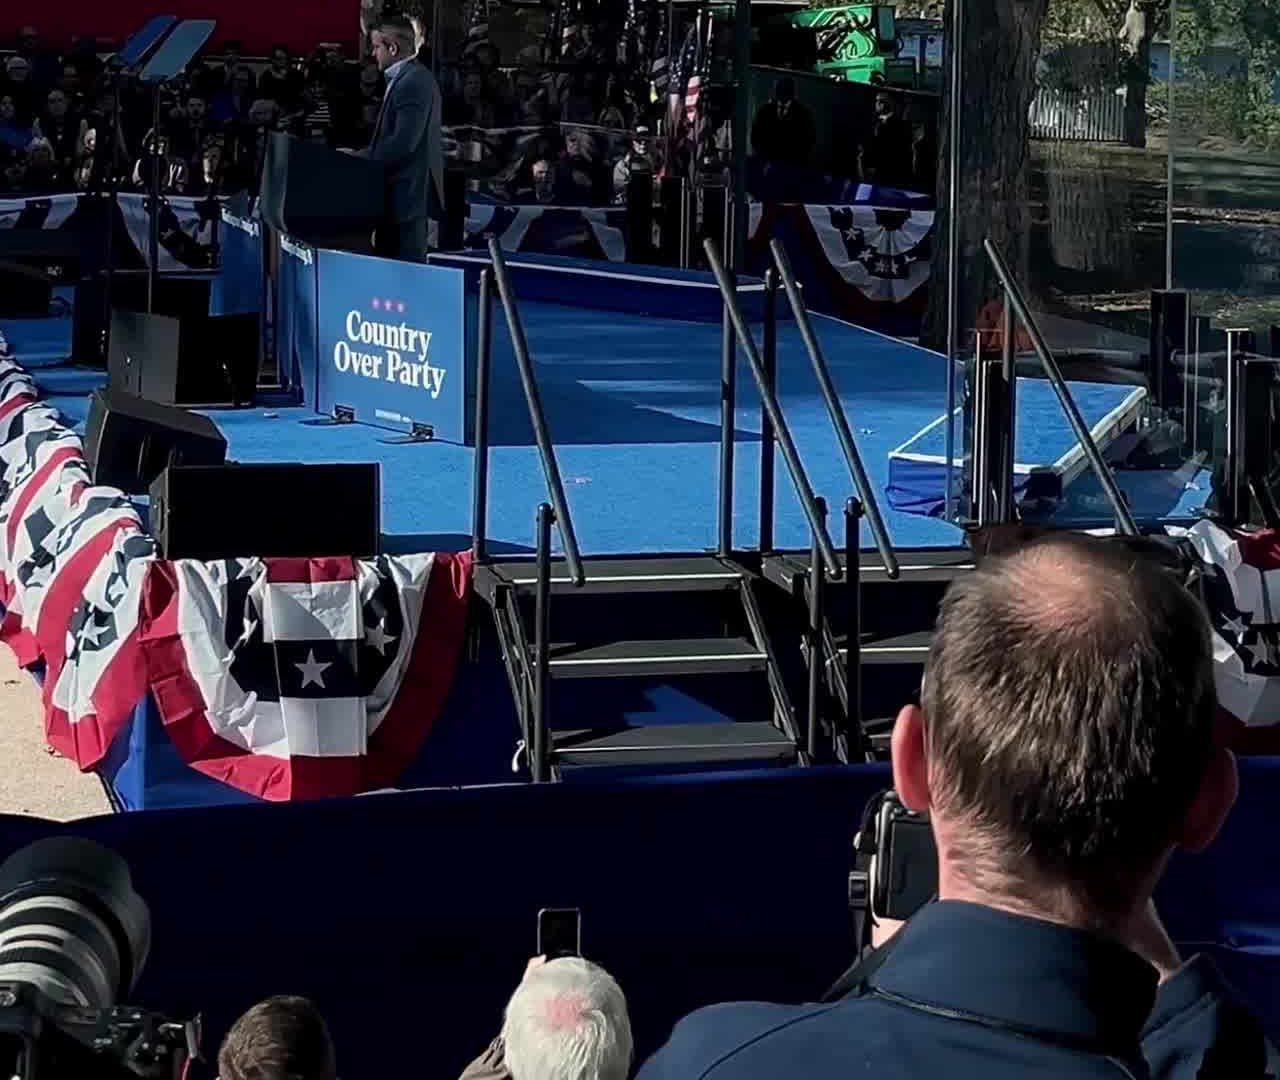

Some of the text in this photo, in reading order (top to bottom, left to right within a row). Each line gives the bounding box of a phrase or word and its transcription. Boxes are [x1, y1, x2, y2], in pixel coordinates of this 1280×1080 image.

[345, 309, 433, 363] Country
[333, 340, 447, 400] Over Party
